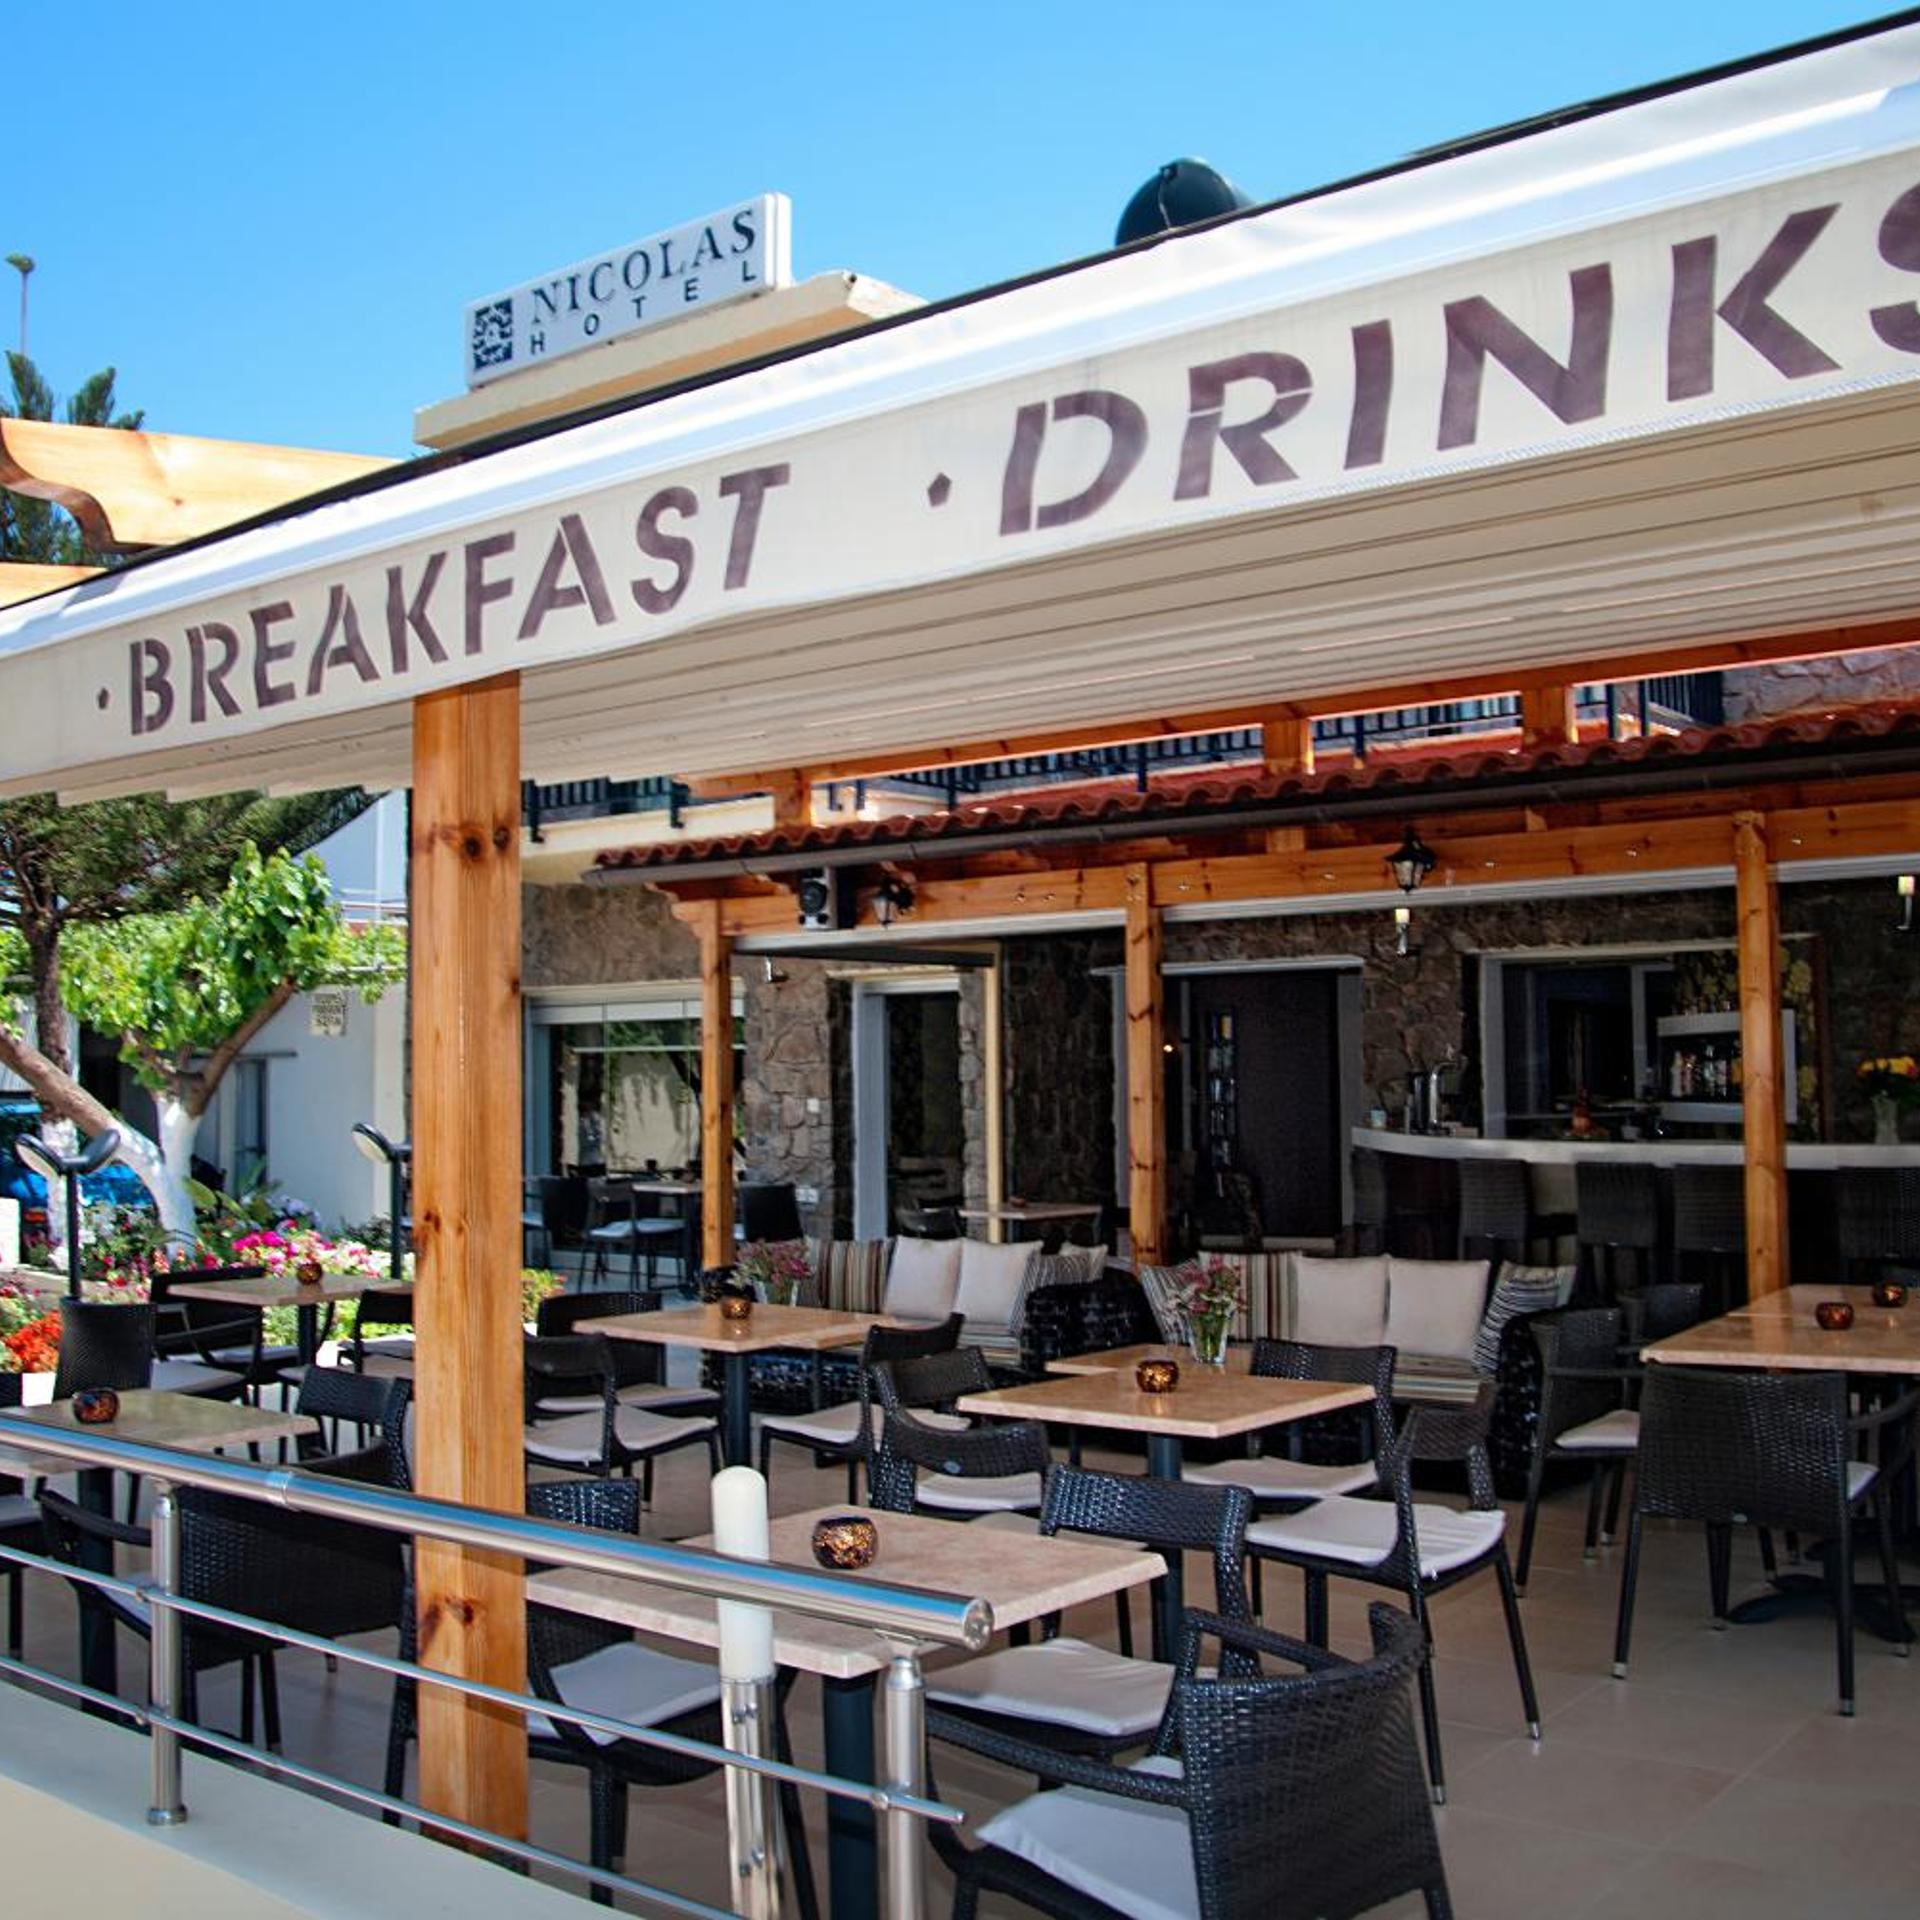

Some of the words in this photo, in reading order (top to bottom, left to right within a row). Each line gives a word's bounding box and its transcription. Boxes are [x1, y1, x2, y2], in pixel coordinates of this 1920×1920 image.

[530, 260, 757, 356] HOTEL
[531, 210, 756, 325] NICOLAS
[130, 462, 790, 736] BREAKFAST
